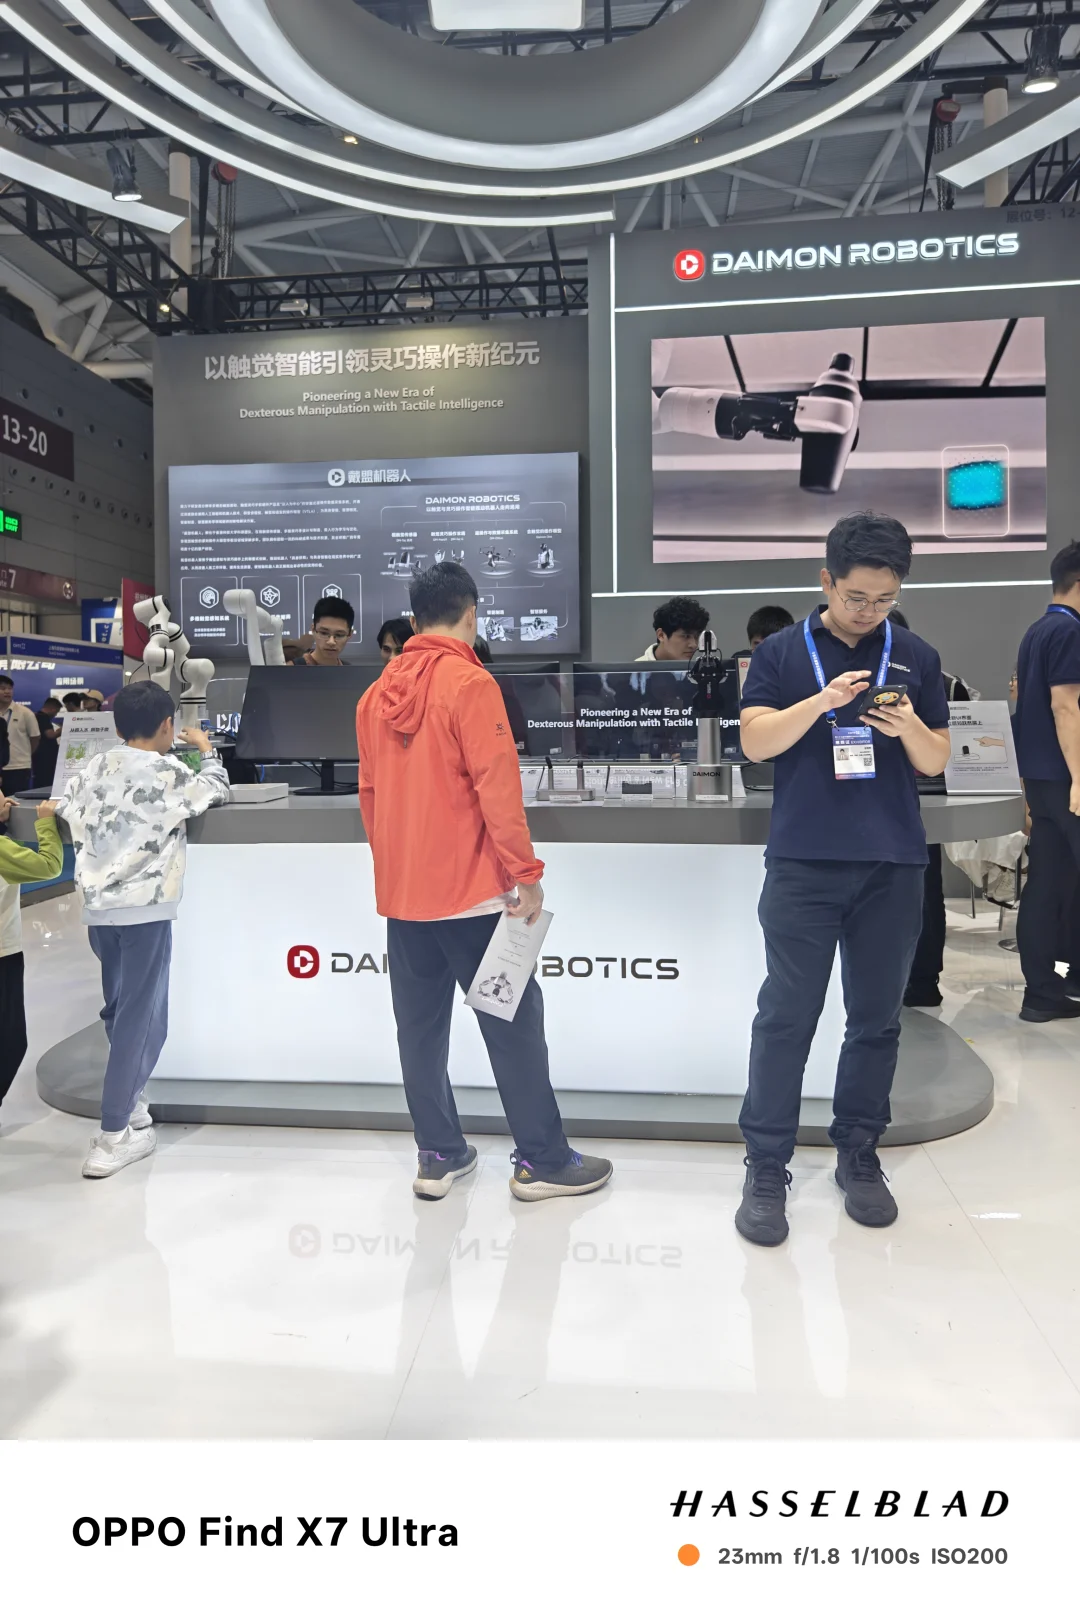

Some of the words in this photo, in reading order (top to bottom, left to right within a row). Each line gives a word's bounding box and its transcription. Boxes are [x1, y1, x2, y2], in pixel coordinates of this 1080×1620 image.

[711, 243, 842, 274] DAIMON
[848, 232, 1020, 265] ROBOTICS
[203, 340, 541, 381] 以触觉智能引领灵巧操作新纪元
[302, 389, 361, 403] Pioneering
[364, 391, 371, 399] a
[374, 388, 399, 399] New
[402, 387, 420, 397] Era
[422, 386, 435, 397] of
[239, 408, 295, 419] Dexterous
[297, 402, 370, 417] Manipulation
[373, 401, 398, 412] with
[400, 399, 436, 411] Tactile
[439, 397, 504, 411] Intelligence
[2, 414, 48, 456] 13-20
[347, 467, 412, 484] 戴盟机器人
[425, 497, 467, 505] DAIMON
[468, 494, 521, 503] ROBOTICS
[8, 568, 17, 589] 7
[580, 708, 630, 719] Pioneering
[640, 708, 662, 716] New
[664, 708, 680, 716] Era
[682, 707, 693, 716] of
[527, 719, 574, 728] Dexterous
[576, 719, 637, 730] Manipulation
[639, 718, 661, 727] with
[663, 718, 693, 727] Tactile
[331, 952, 388, 974] DAI
[533, 956, 680, 981] BOTICS
